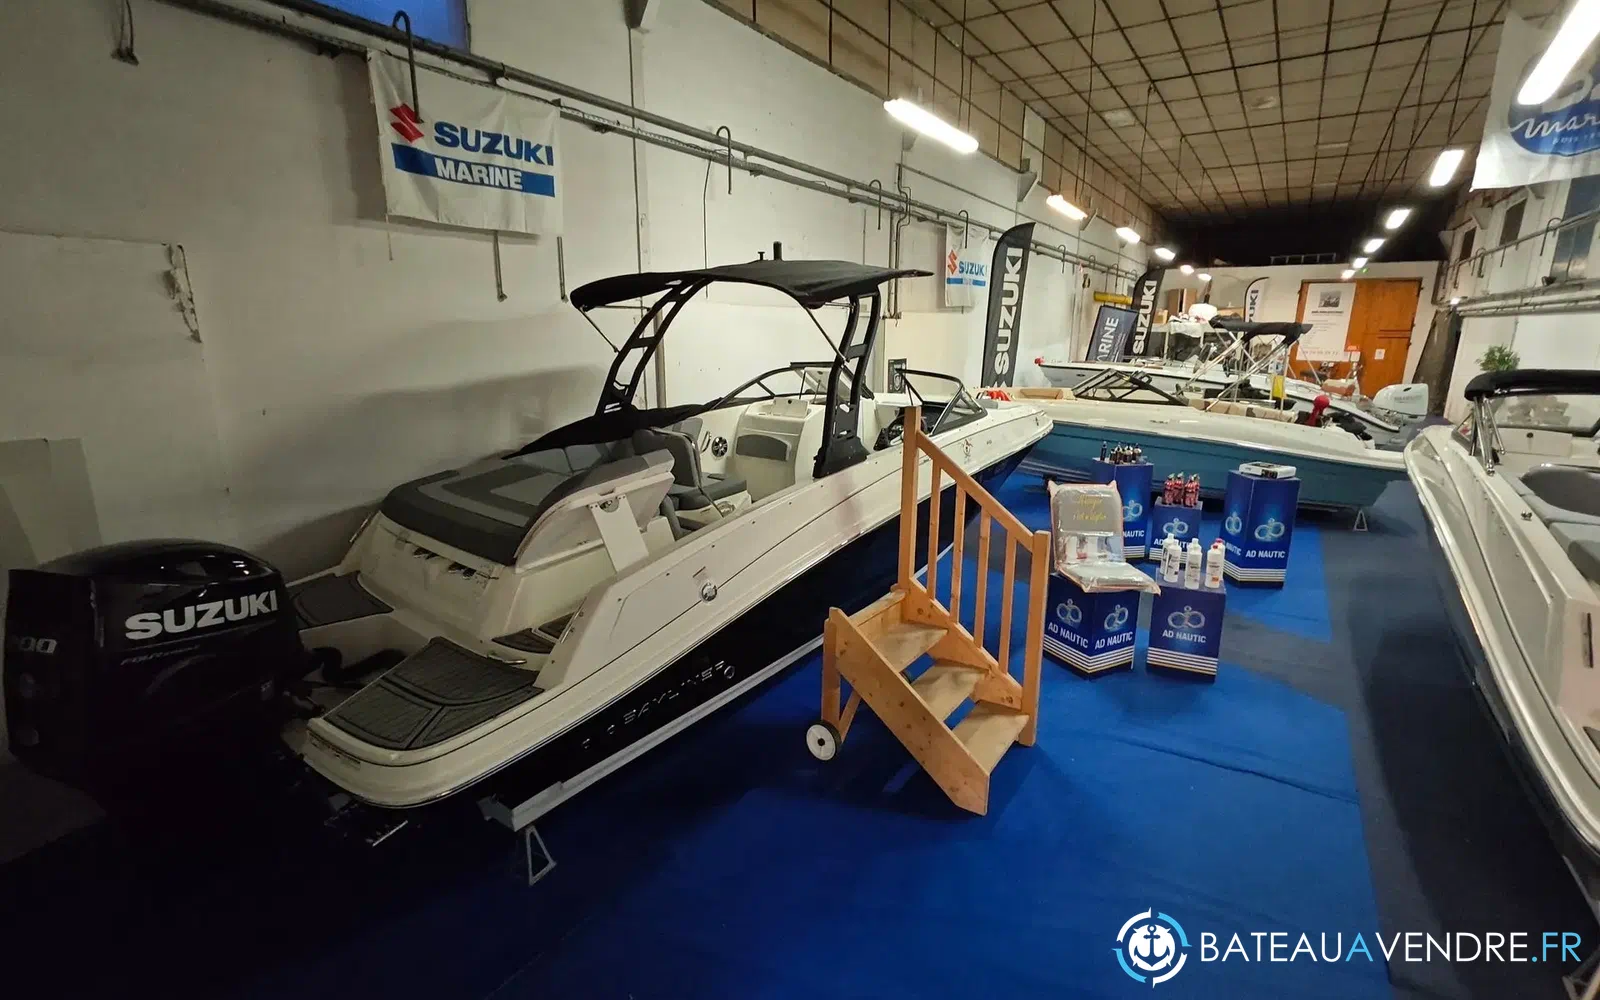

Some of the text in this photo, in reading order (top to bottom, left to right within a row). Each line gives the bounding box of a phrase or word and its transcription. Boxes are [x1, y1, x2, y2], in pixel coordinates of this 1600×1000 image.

[434, 121, 555, 167] SUZUKI
[434, 157, 523, 190] MARINE
[958, 261, 988, 277] SUZUKI
[994, 247, 1024, 375] SUZUKI
[1132, 280, 1158, 355] SUZUKI
[1245, 550, 1286, 559] AD NAUTIC
[124, 590, 279, 641] SUZUKI
[1048, 622, 1089, 648] AD NAUTIC
[1094, 632, 1133, 650] AD NAUTIC
[1162, 629, 1207, 644] AD NAUTIC
